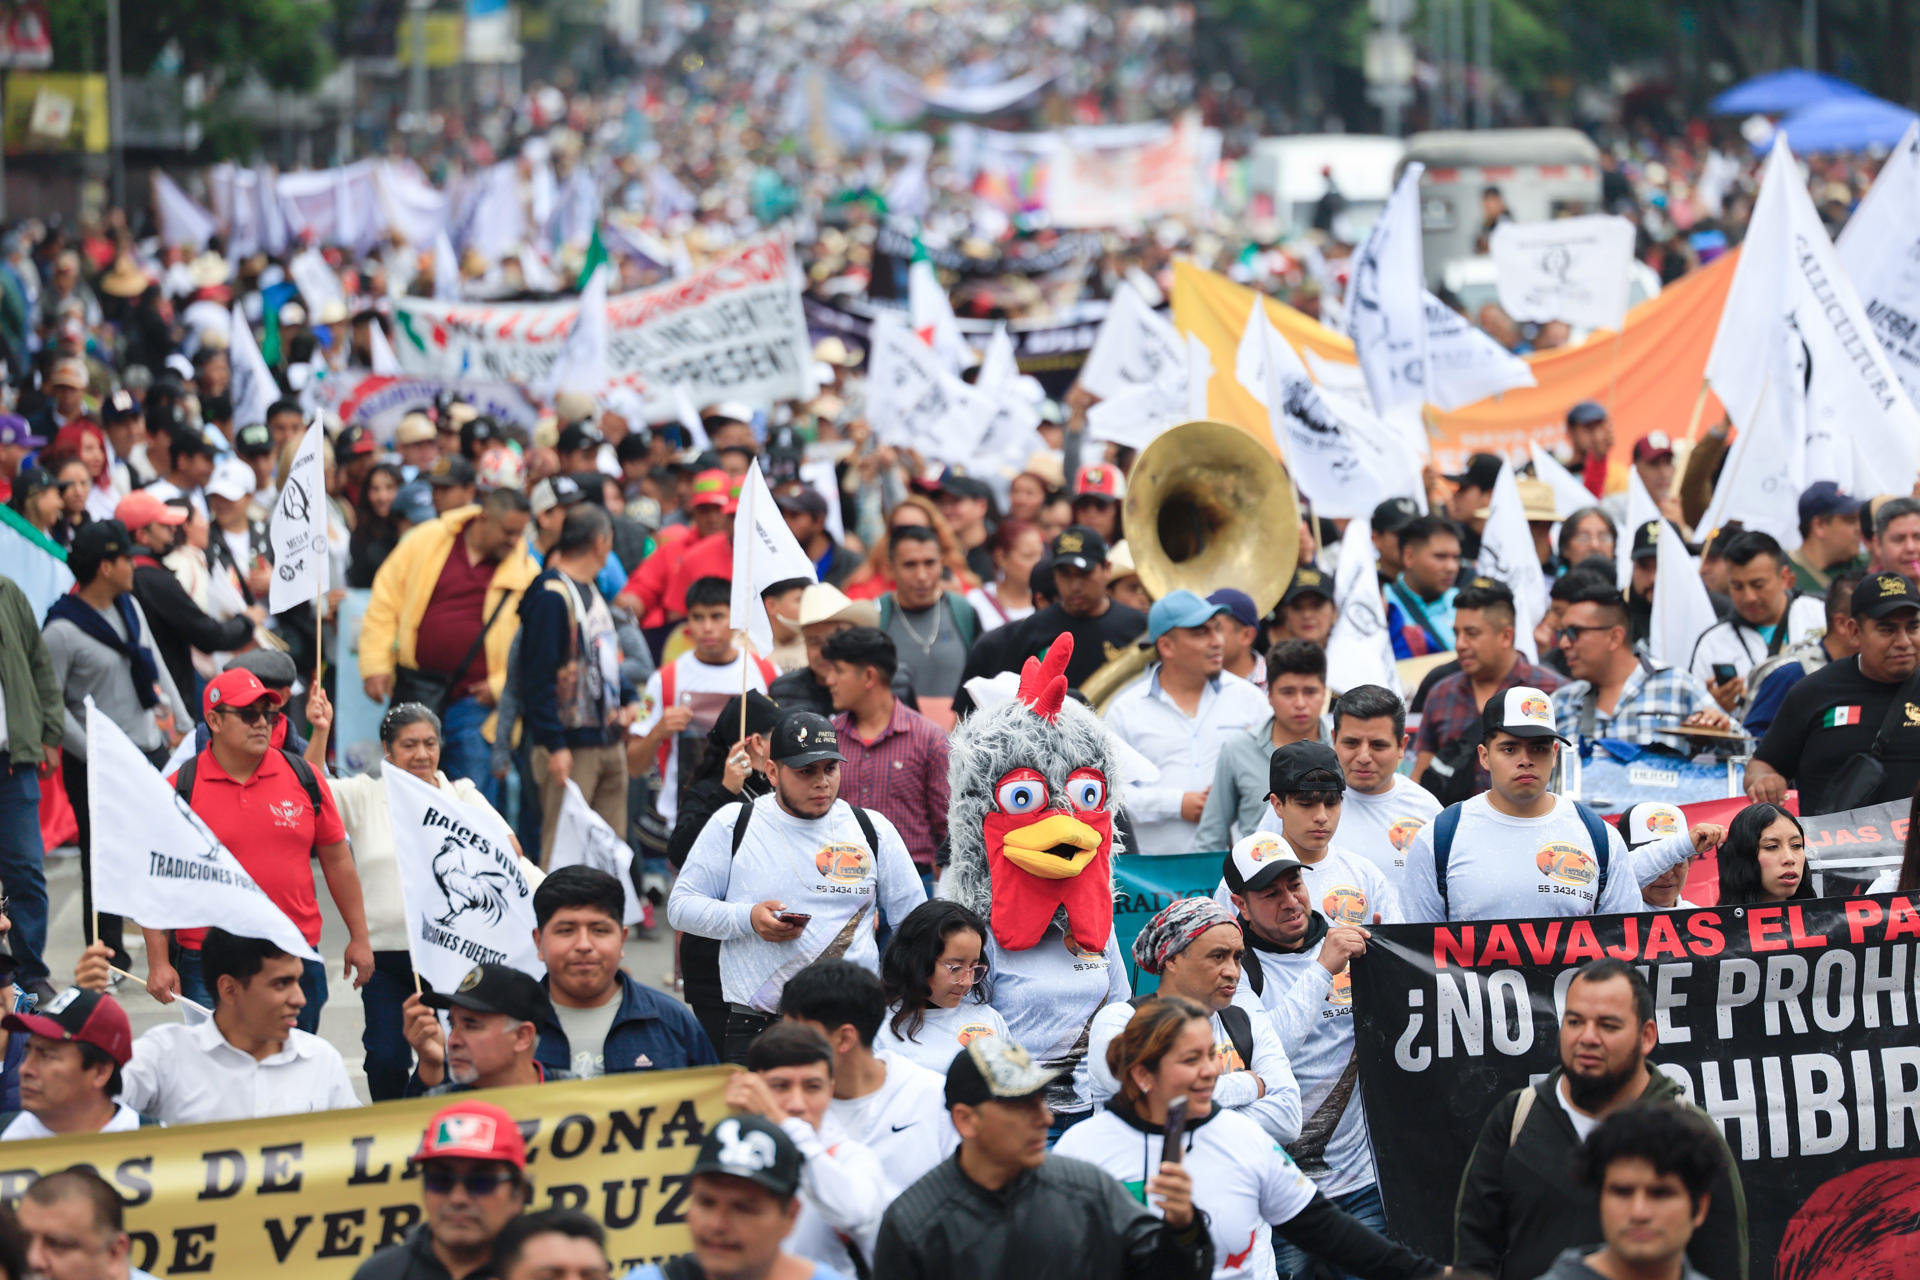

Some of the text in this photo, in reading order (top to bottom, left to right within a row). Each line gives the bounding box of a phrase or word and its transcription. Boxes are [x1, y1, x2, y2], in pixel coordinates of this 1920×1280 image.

[1804, 825, 1883, 849] JAS
[150, 851, 232, 885] TRADICIONES
[816, 885, 828, 893] 55
[830, 886, 852, 894] 3434
[1538, 884, 1550, 893] 55
[1553, 886, 1576, 896] 3434
[1433, 911, 1726, 969] NAVAJAS
[1747, 905, 1828, 952] EL
[1322, 1010, 1334, 1018] 55
[1394, 968, 1535, 1073] ¿NO
[197, 1141, 304, 1201] DE
